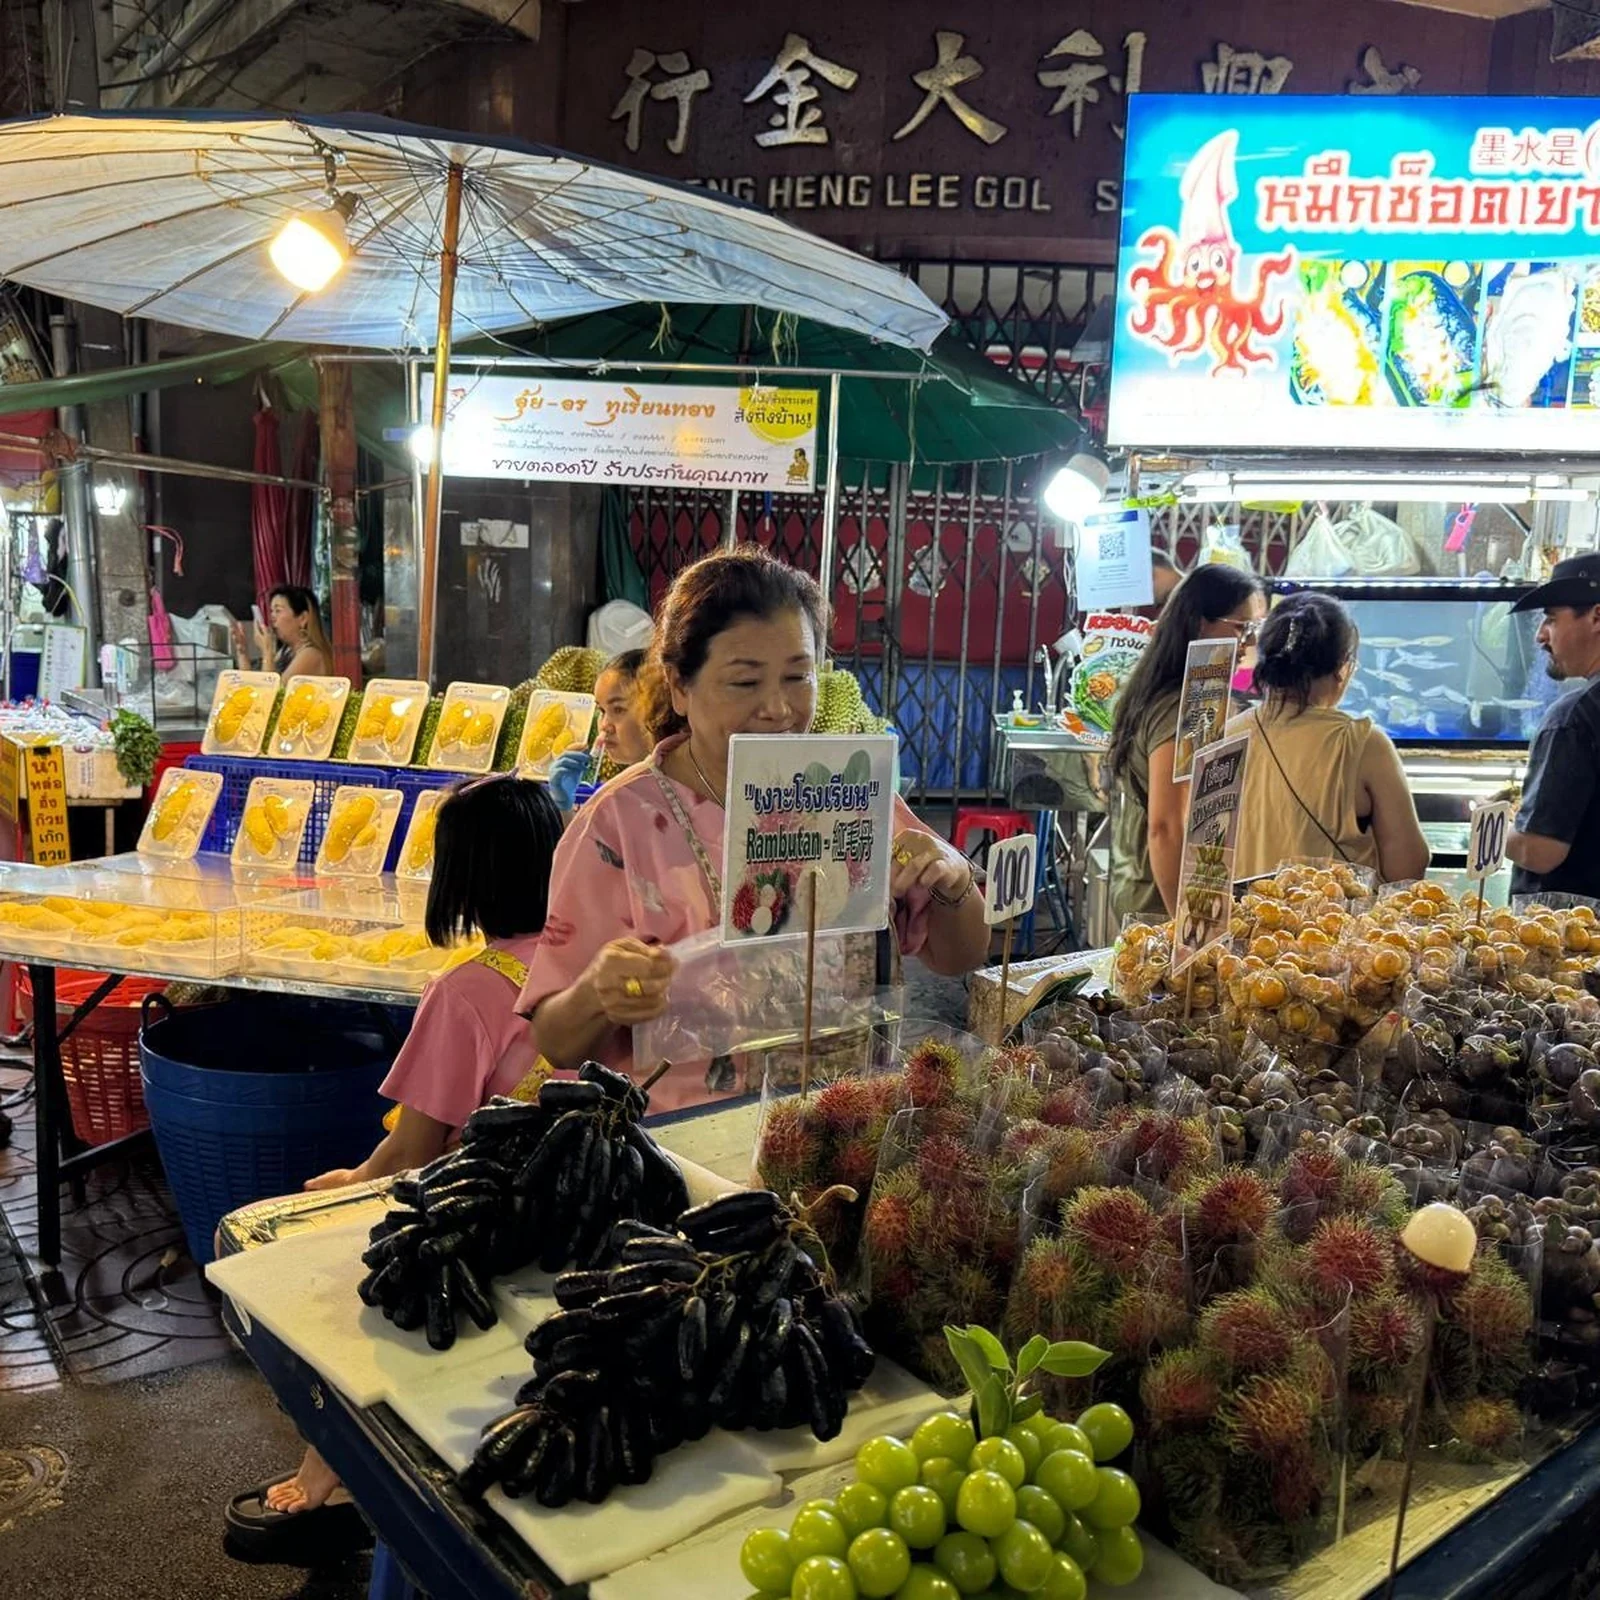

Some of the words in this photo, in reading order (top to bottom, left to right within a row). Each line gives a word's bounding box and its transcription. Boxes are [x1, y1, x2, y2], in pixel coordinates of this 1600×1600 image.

[768, 174, 871, 210] HENG
[885, 173, 960, 209] LEE
[974, 175, 1052, 211] GOL
[603, 463, 769, 486] รับประกันคุณภาพ
[746, 827, 822, 864] Rambutan
[1474, 810, 1505, 872] 100
[992, 844, 1031, 912] 100
